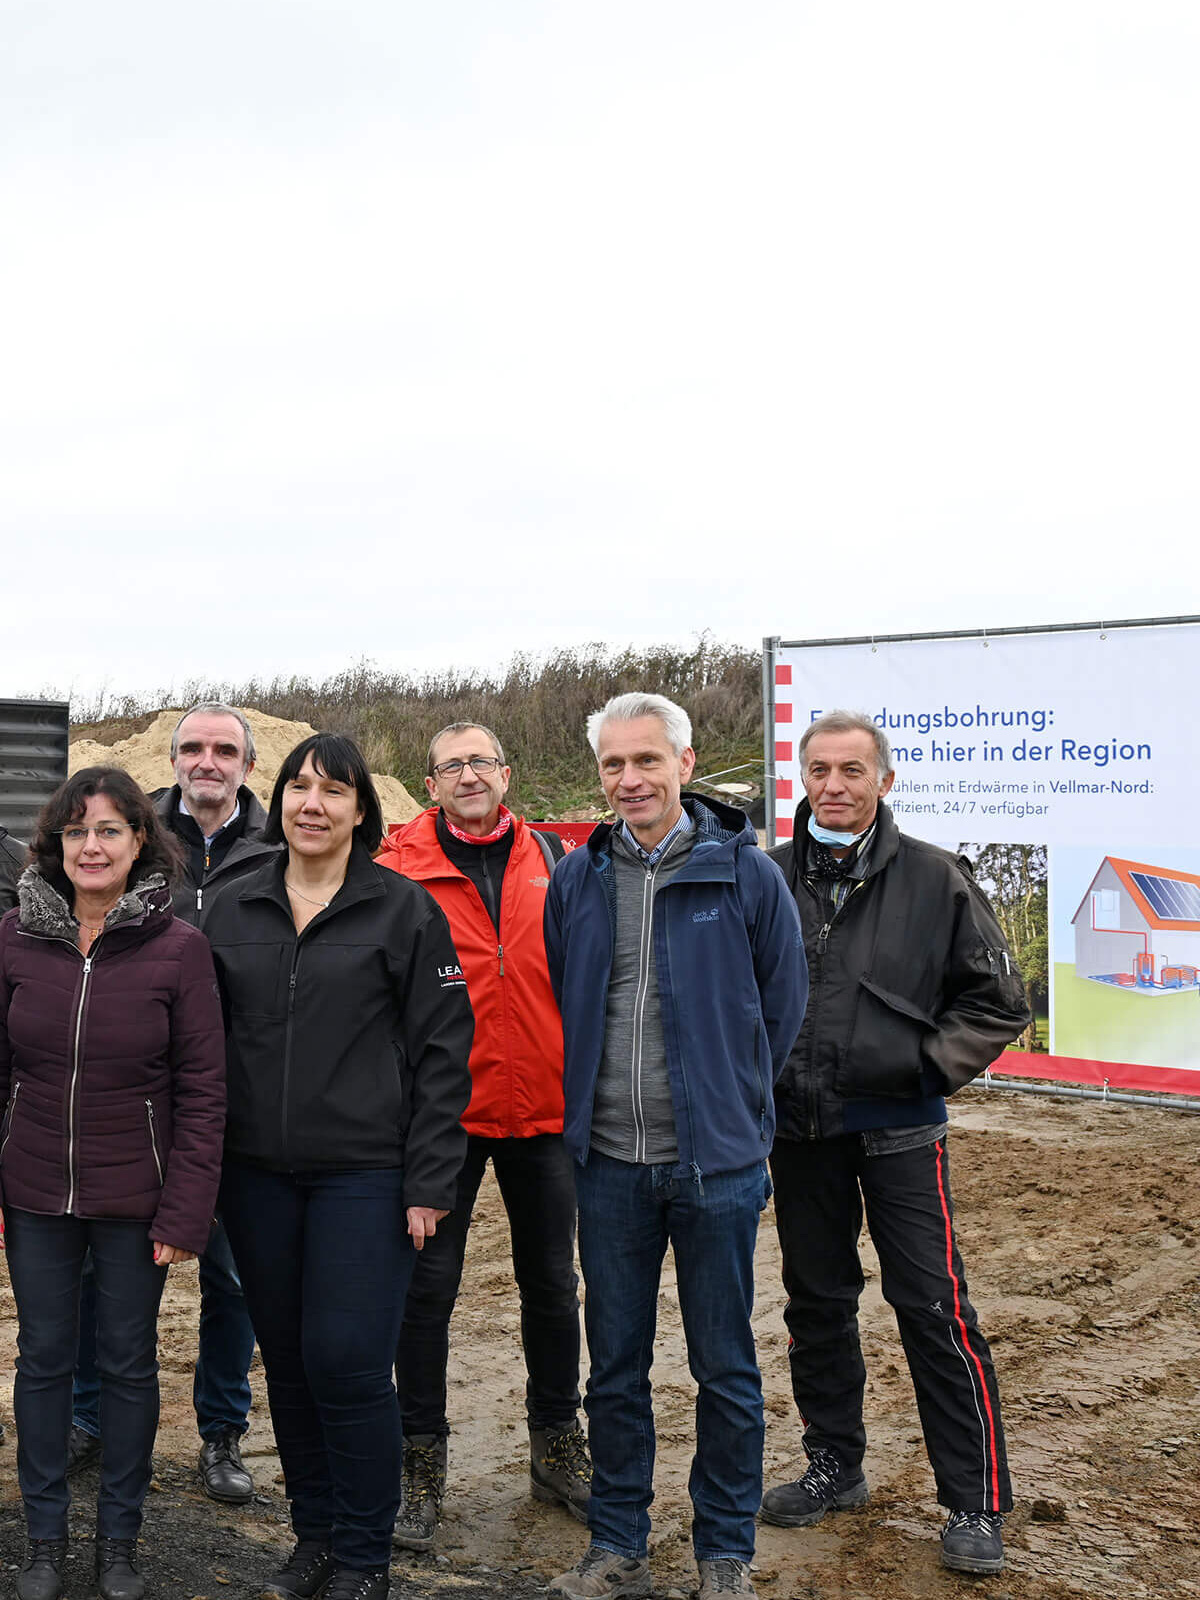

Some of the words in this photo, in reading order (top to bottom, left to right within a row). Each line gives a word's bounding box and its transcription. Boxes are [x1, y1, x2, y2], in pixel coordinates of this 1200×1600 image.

[932, 739, 976, 761] hier
[983, 740, 1003, 761] in
[1012, 738, 1053, 761] der
[1061, 738, 1151, 767] Region
[891, 779, 929, 793] ühlen
[933, 780, 954, 793] mit
[959, 780, 1029, 793] Erdwärme
[1033, 780, 1045, 793] in
[1049, 780, 1154, 793] Vellmar-Nord:
[943, 801, 976, 814] 24/7
[980, 801, 1049, 818] verfügbar
[437, 965, 462, 977] LEA
